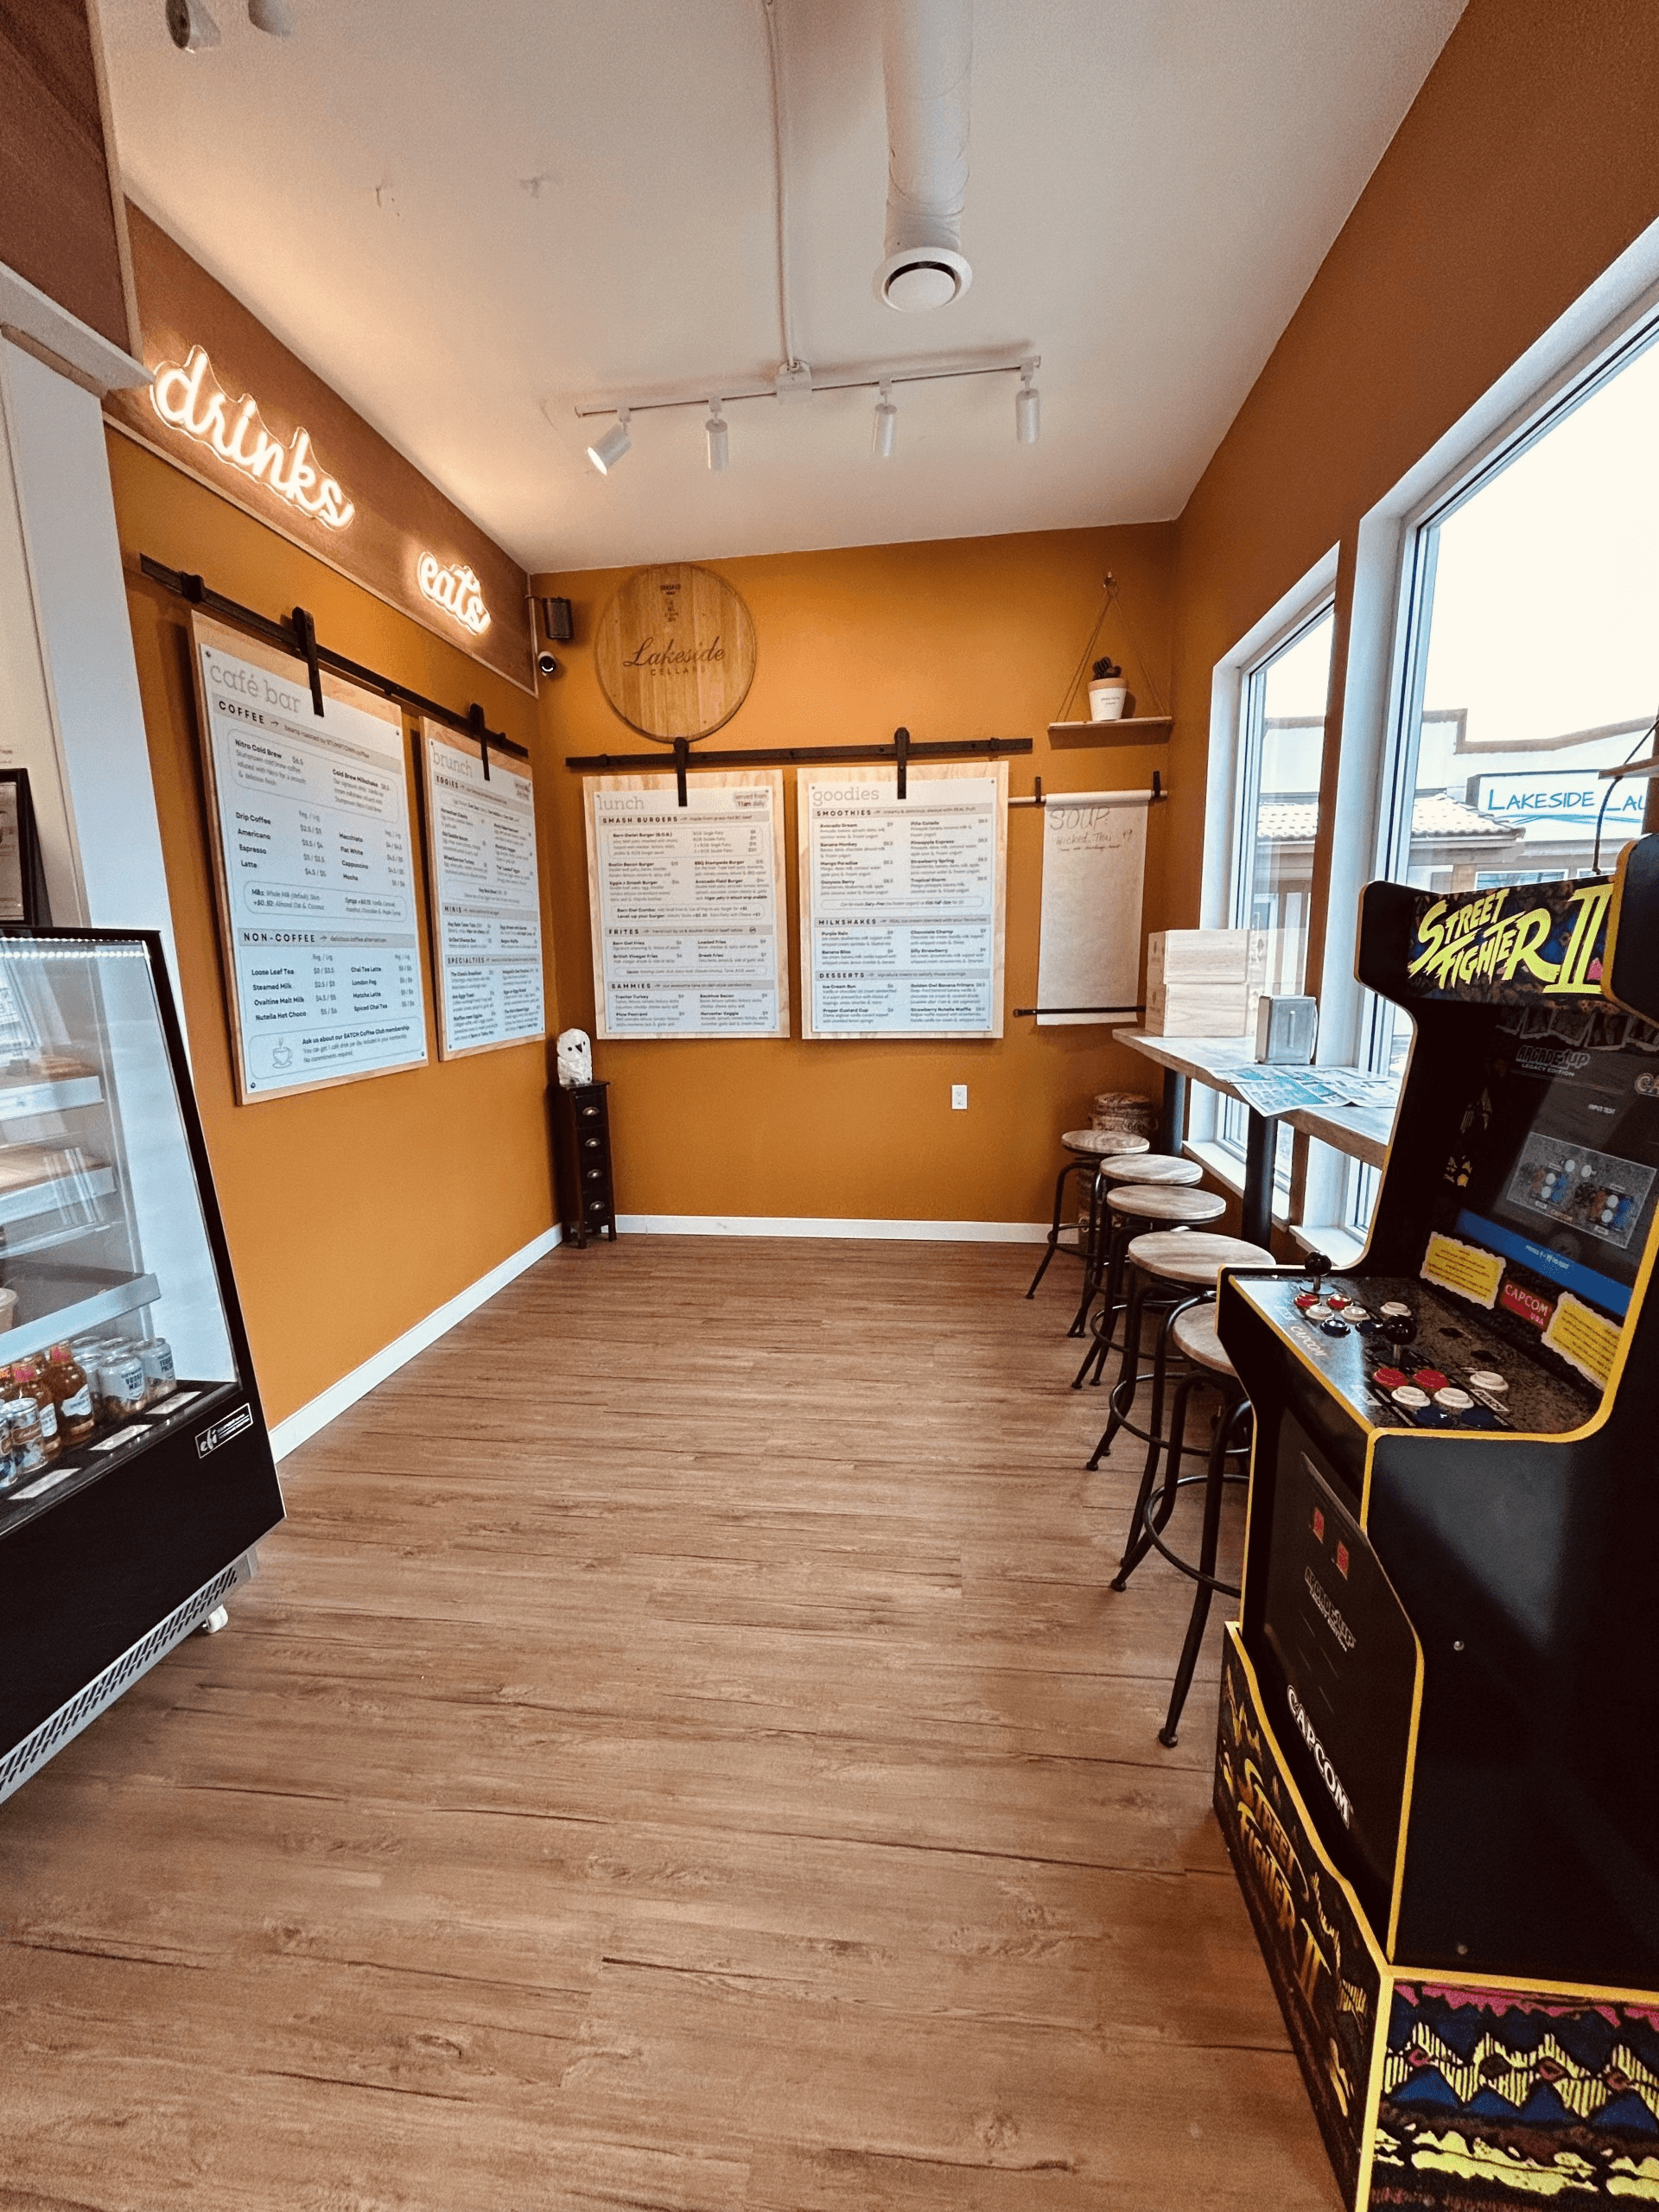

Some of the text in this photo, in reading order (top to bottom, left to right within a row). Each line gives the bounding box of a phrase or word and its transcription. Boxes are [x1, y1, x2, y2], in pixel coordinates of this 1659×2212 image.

[155, 352, 355, 528] drinks
[420, 556, 492, 632] eats
[622, 635, 726, 668] Lakeside
[650, 665, 706, 677] CELLARS
[210, 664, 302, 713] café bar
[219, 701, 265, 724] COFFEE
[234, 739, 282, 759] Nitro Cold Brew
[432, 747, 474, 778] brunch
[598, 796, 645, 810] lunch
[812, 785, 880, 807] goodies
[1487, 788, 1596, 810] LAKESIDE
[235, 811, 250, 822] Drip
[250, 814, 271, 825] Coffee
[237, 828, 271, 840] Americano
[238, 843, 267, 855] Espresso
[240, 860, 257, 868] Latte
[244, 932, 315, 943] NON-COFFEE
[1408, 887, 1510, 980] STREET
[1425, 883, 1616, 995] FIGHTER II
[368, 978, 377, 987] Fog
[289, 1010, 307, 1019] Choco
[320, 1035, 334, 1044] about
[344, 1031, 359, 1039] BATCH
[385, 1025, 410, 1033] membership
[1521, 1063, 1575, 1077] LEGACY EDITION
[1504, 1284, 1549, 1317] CAPCOM
[1530, 1313, 1545, 1327] USA
[1290, 1325, 1328, 1357] CAPCOM
[1287, 1685, 1351, 1830] CAPCOM
